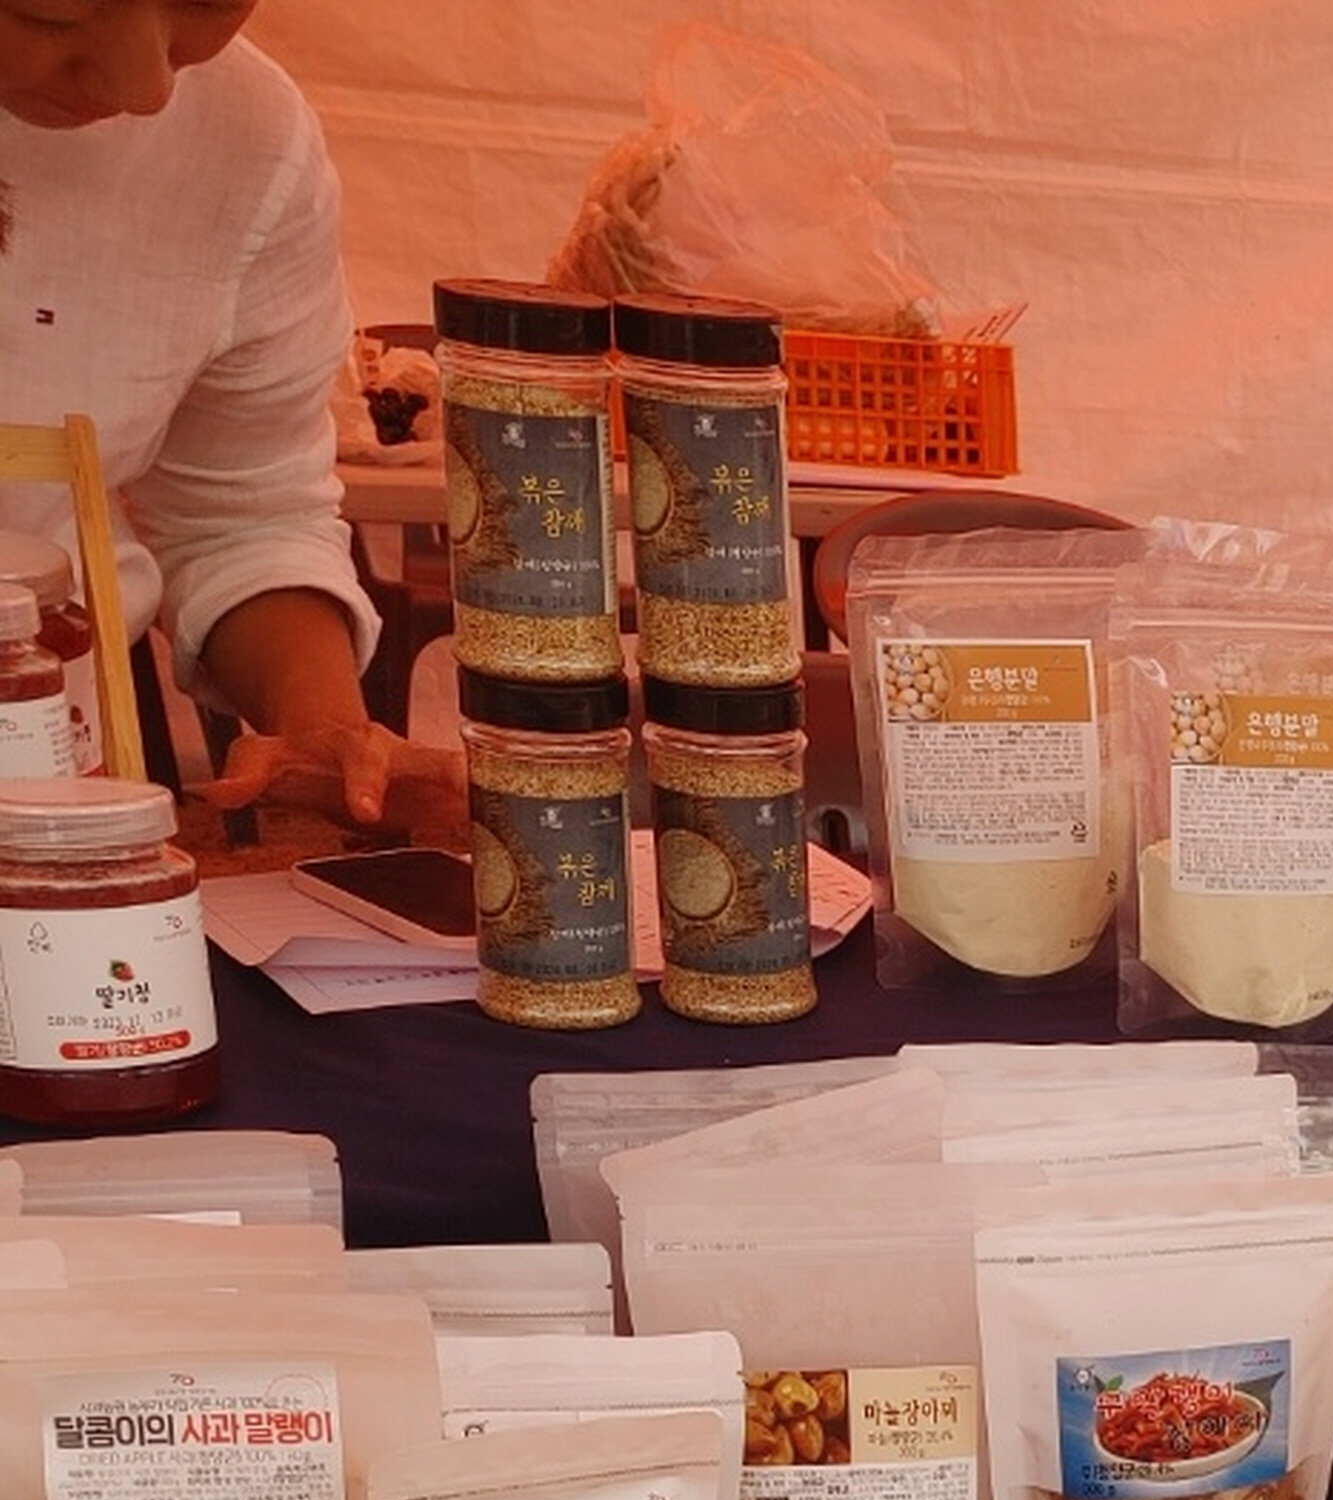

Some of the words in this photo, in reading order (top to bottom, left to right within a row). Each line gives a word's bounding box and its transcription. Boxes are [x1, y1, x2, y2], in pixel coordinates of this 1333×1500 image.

[520, 474, 565, 505] 볶은
[710, 464, 754, 494] 볶은
[968, 666, 1038, 691] 은행분말
[1247, 711, 1319, 738] 은행분말
[557, 852, 597, 879] 볶은
[864, 1396, 958, 1426] 마늘장아찌
[54, 1413, 174, 1449] 달콤이의
[182, 1412, 240, 1446] 사과
[244, 1411, 333, 1444] 말랭이
